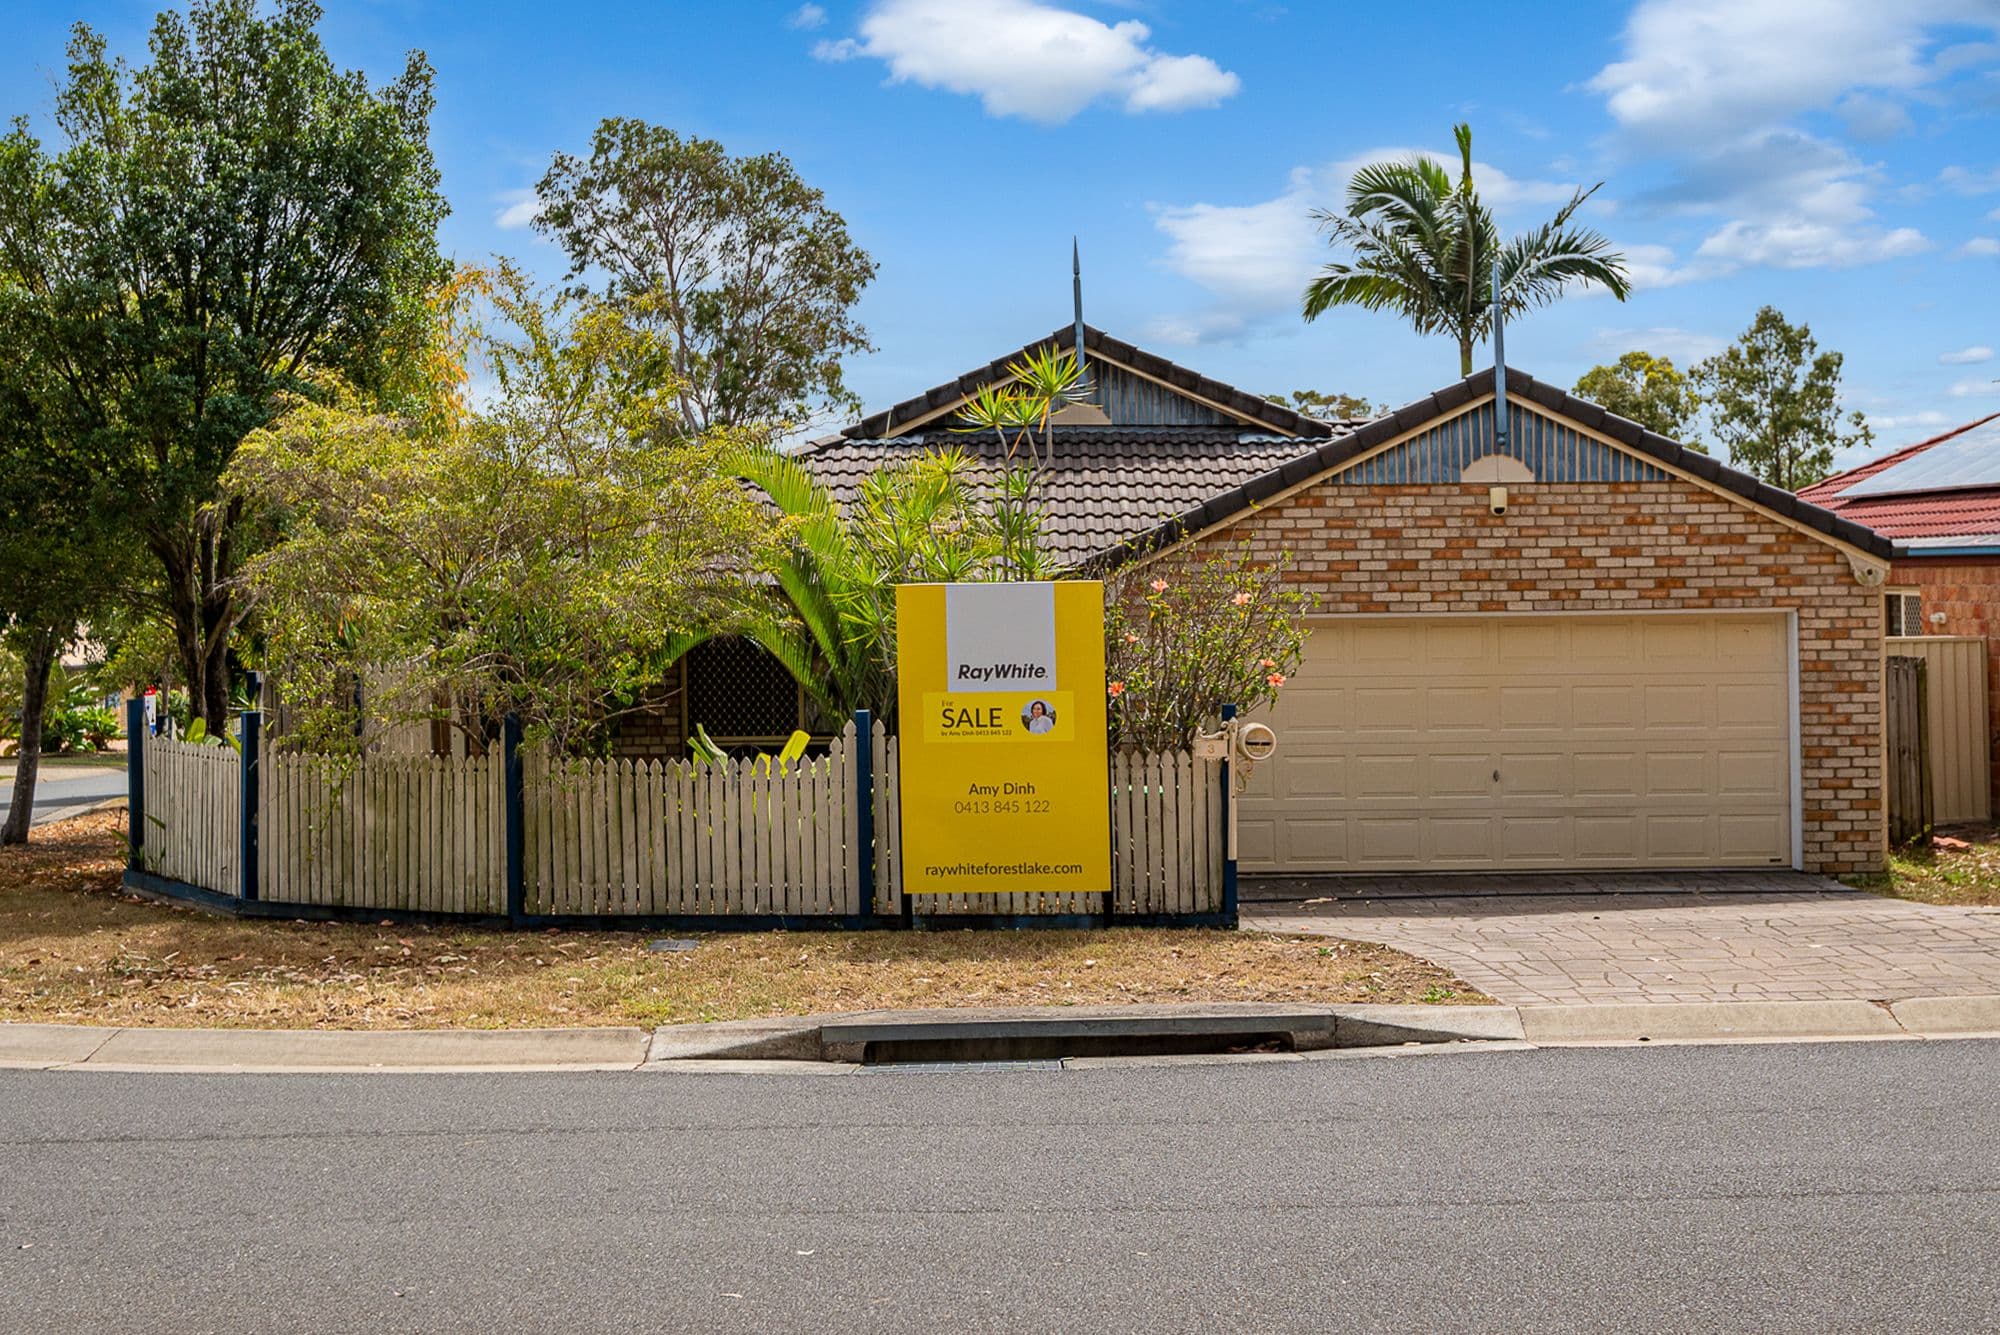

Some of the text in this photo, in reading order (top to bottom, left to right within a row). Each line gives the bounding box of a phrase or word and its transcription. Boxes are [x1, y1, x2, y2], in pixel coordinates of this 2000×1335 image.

[942, 707, 1003, 728] SALE
[1208, 744, 1215, 754] 3
[969, 782, 1035, 797] Amy Dinh
[955, 800, 1050, 813] 0413 845 122
[925, 862, 1083, 877] raywhiteforestlake.com
